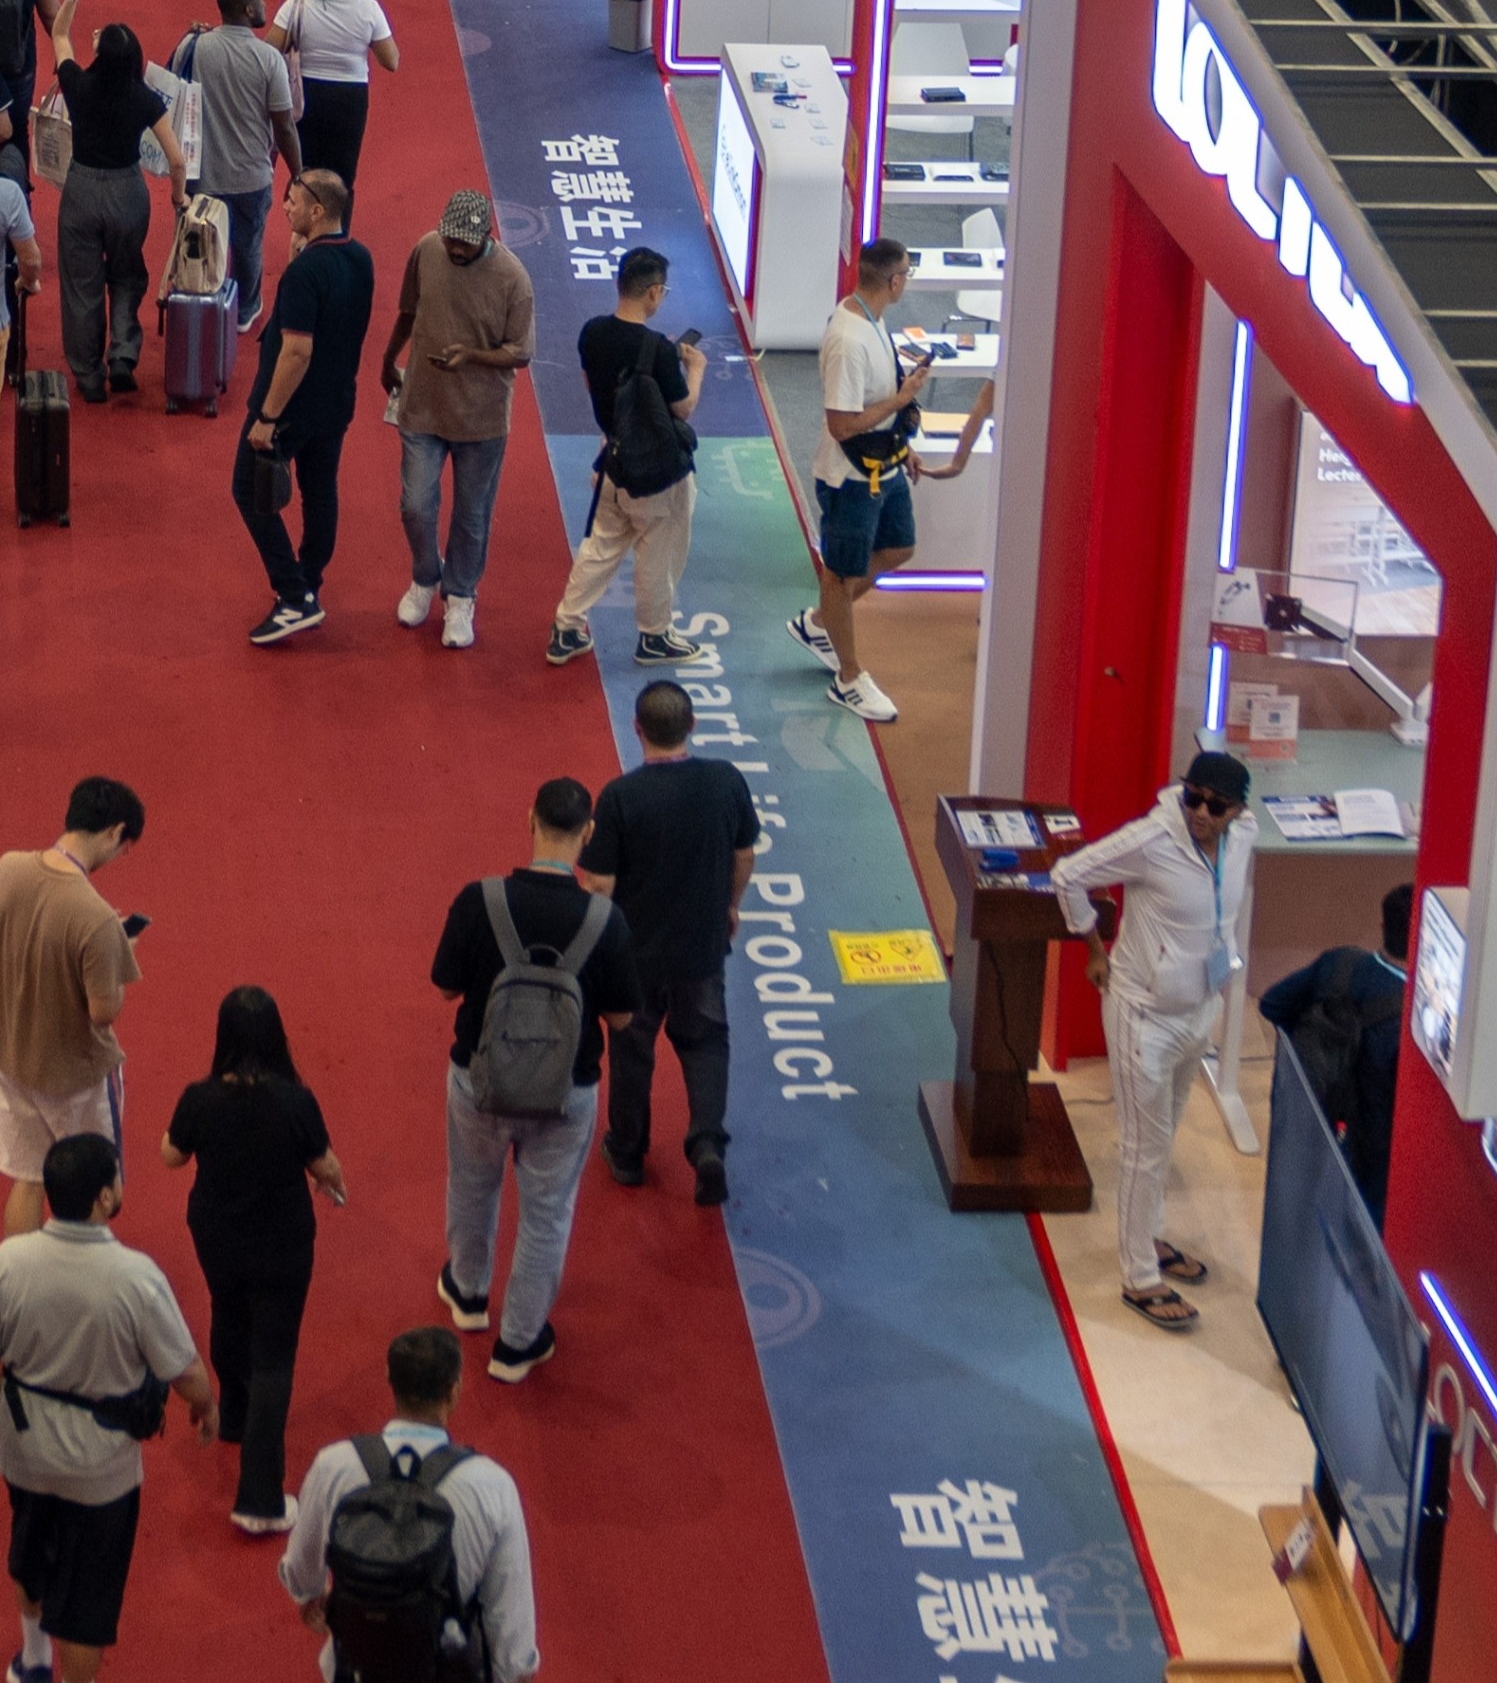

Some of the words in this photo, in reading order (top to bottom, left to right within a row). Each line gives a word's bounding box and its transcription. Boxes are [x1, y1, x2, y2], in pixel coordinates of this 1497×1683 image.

[673, 611, 760, 748] Smart
[743, 872, 860, 1102] Product
[889, 1477, 1067, 1683] 智慧
